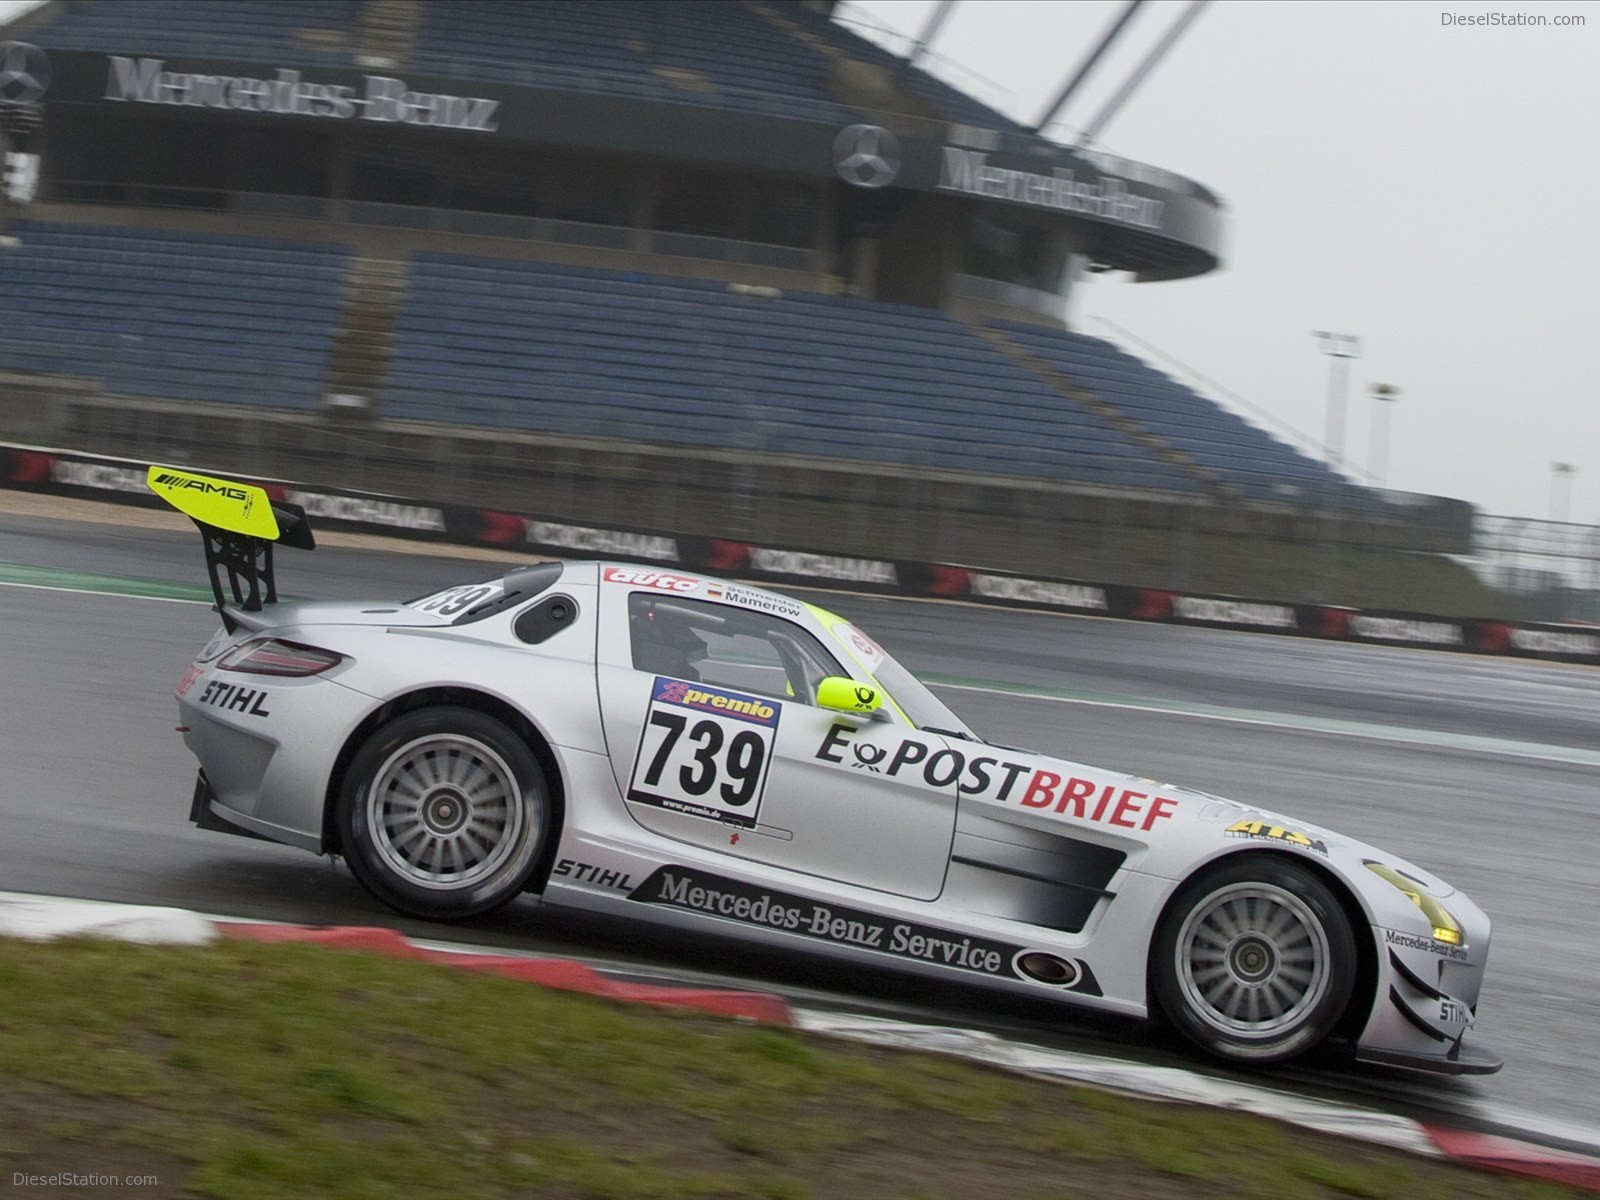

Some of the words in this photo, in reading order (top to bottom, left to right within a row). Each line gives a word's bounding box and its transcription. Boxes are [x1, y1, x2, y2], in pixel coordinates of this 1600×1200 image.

[105, 56, 500, 132] Mercedes-Benz
[182, 480, 247, 501] AMG
[609, 569, 700, 592] auto
[725, 591, 801, 617] Mamerow
[199, 680, 270, 718] STIHL
[682, 688, 774, 719] premio
[644, 709, 765, 807] 739
[662, 800, 721, 819] www.premio.de
[553, 859, 634, 892] STIHL
[658, 872, 884, 947] Mercedes-Benz
[889, 924, 1002, 972] Service
[1385, 930, 1448, 956] Mercedes-Benz
